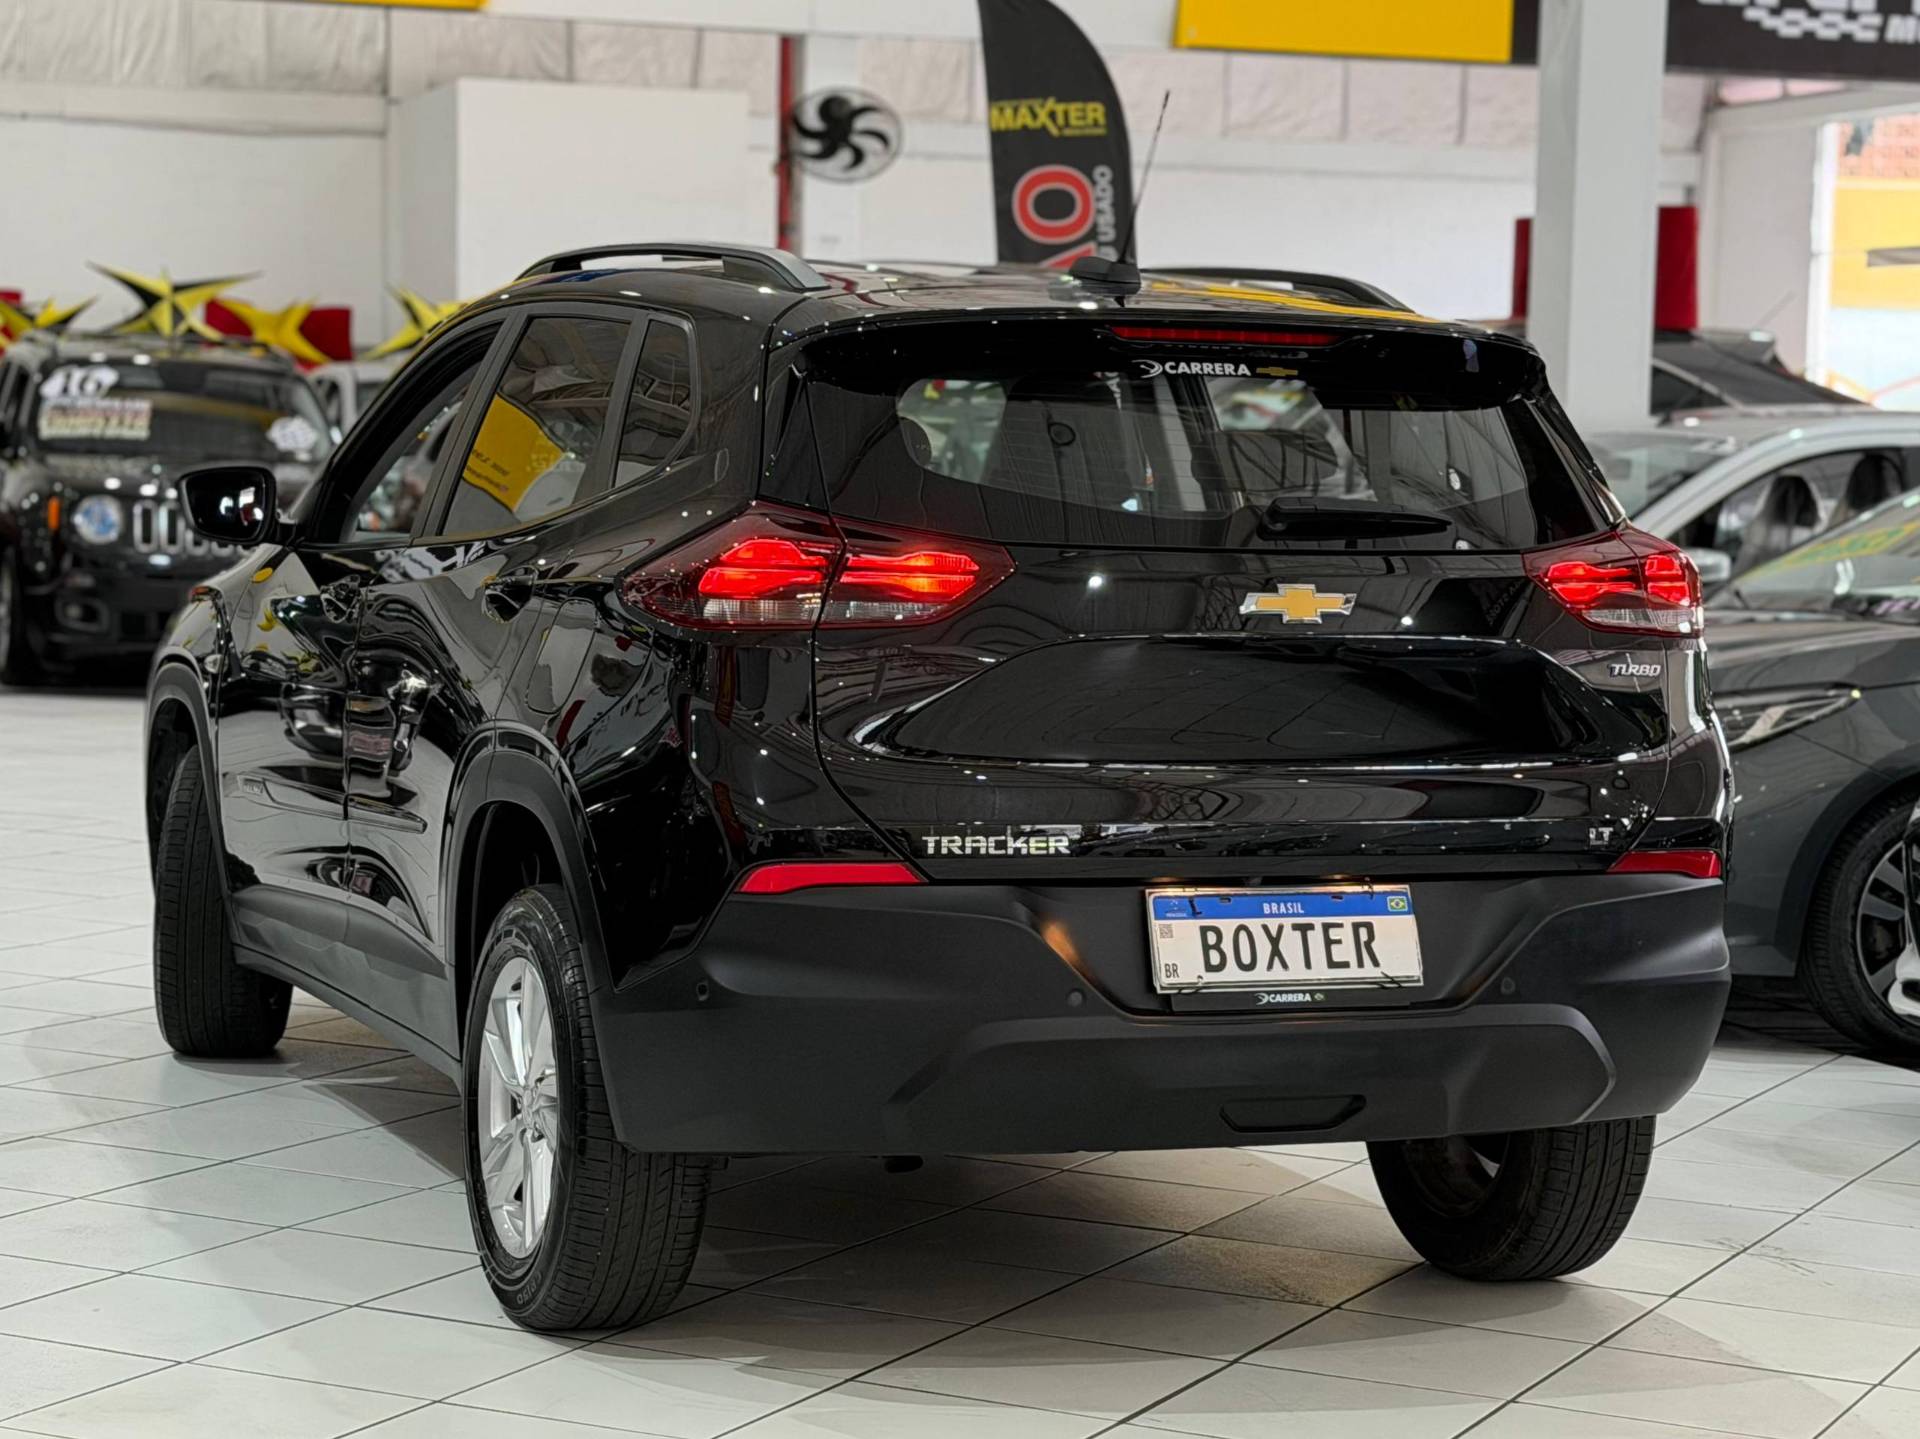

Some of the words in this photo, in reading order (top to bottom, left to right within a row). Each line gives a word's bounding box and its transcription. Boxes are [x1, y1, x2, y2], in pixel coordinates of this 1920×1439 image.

[989, 97, 1107, 137] MAXTER
[1093, 164, 1116, 242] USADO
[1164, 361, 1251, 377] CARRERA
[1610, 662, 1661, 678] TURBO
[922, 835, 1071, 855] TRACKER
[1589, 827, 1614, 846] LT
[1263, 902, 1305, 915] BRASIL
[1199, 921, 1381, 974] BOXTER
[1164, 963, 1180, 979] BR
[1269, 991, 1312, 1003] CARRERA
